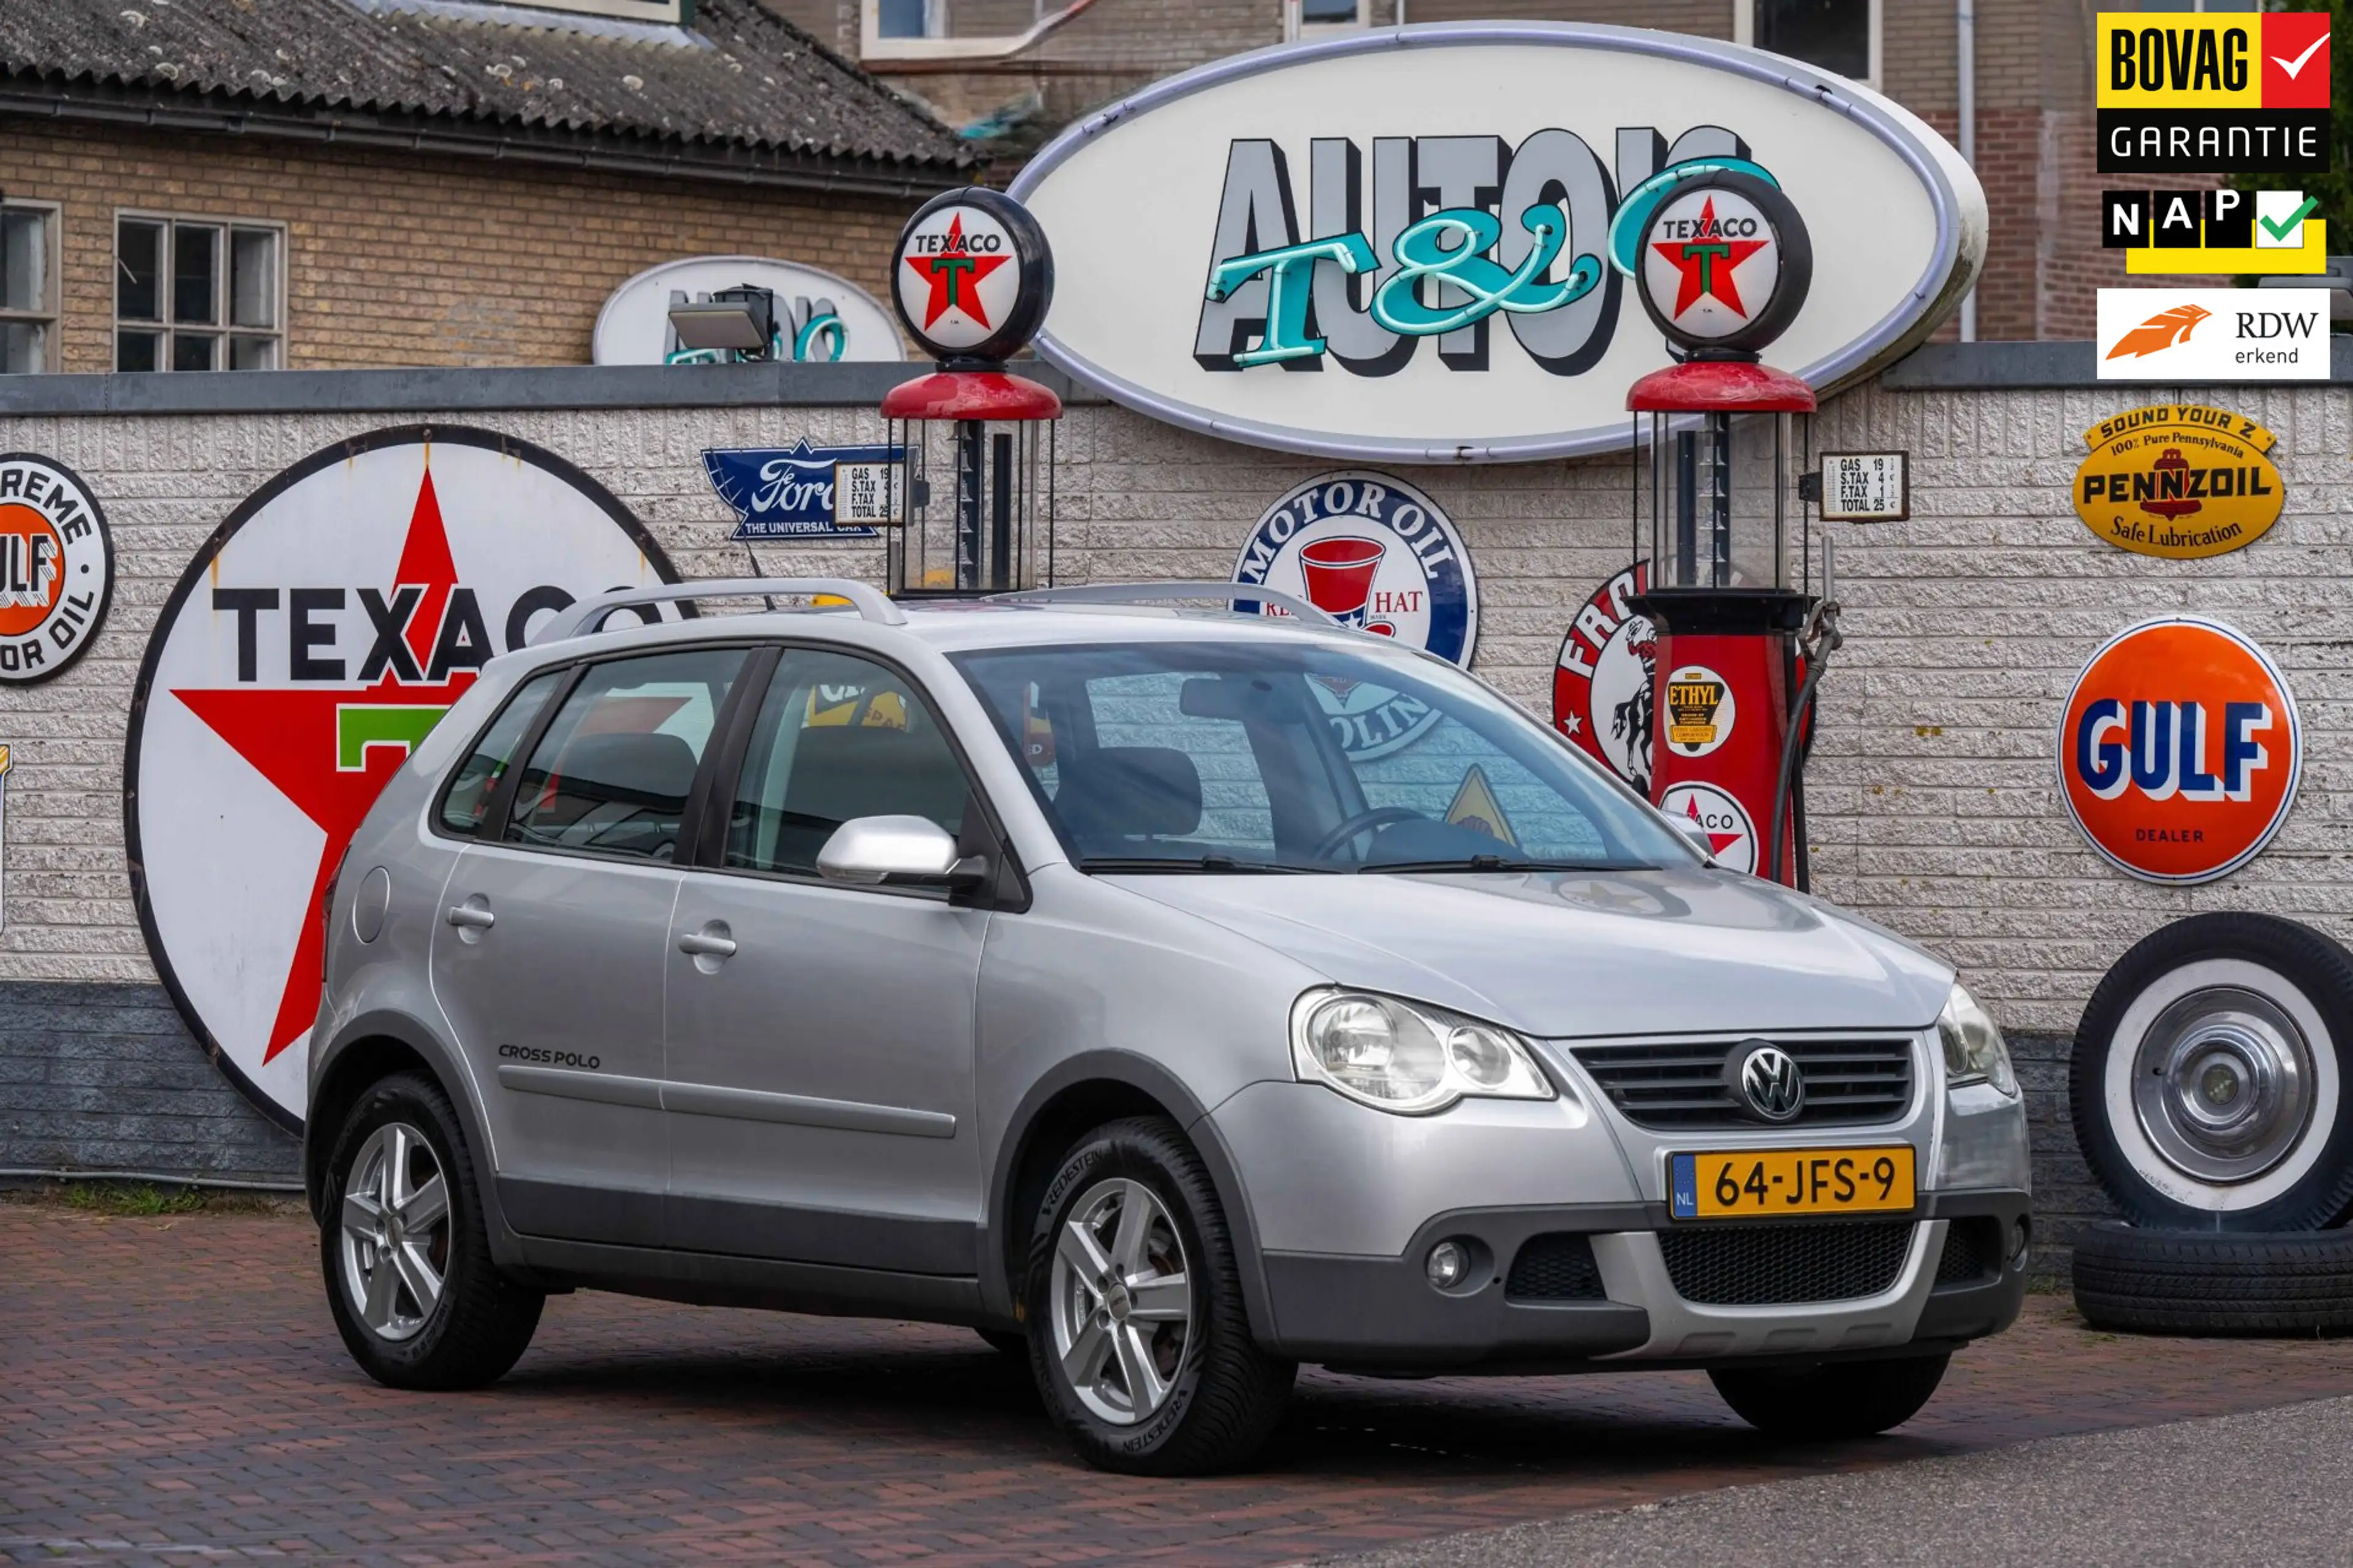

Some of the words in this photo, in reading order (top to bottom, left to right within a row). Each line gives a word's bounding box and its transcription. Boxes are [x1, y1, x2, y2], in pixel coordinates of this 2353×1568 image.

[1664, 218, 1757, 238] TEXACO
[916, 234, 1001, 252] TEXACO
[2101, 407, 2169, 439] SOUND
[2176, 407, 2232, 429] YOUR
[2240, 422, 2257, 439] Z
[2111, 439, 2140, 456] 100%
[2143, 433, 2170, 447] Pure
[2172, 432, 2244, 460] Pennsylvania
[852, 468, 870, 479] GAS
[1840, 458, 1861, 471] GAS
[1873, 458, 1884, 471] 19
[852, 480, 876, 492] S.TAX
[1840, 472, 1869, 485] S.TAX
[1878, 472, 1884, 483] 4
[2084, 467, 2273, 504] PENNZOIL
[852, 493, 874, 505] F.TAX
[1841, 485, 1868, 498] F.TAX
[1879, 486, 1884, 497] 1
[851, 506, 876, 517] TOTAL
[1841, 499, 1870, 512] TOTAL
[1873, 499, 1885, 511] 25
[746, 524, 767, 533] THE
[768, 521, 833, 533] UNIVERSAL
[1242, 482, 1385, 585] MOTOR
[1392, 504, 1454, 580] OIL
[2110, 516, 2145, 542] Safe
[2149, 522, 2243, 547] Lubrication
[1375, 591, 1423, 613] HAT
[49, 591, 94, 650] OIL
[1670, 685, 1718, 705] ETHYL
[2077, 699, 2272, 801] GULF
[2135, 829, 2204, 842] DEALER
[1715, 1157, 1895, 1206] 64-JFS-9
[1676, 1193, 1694, 1206] NL
